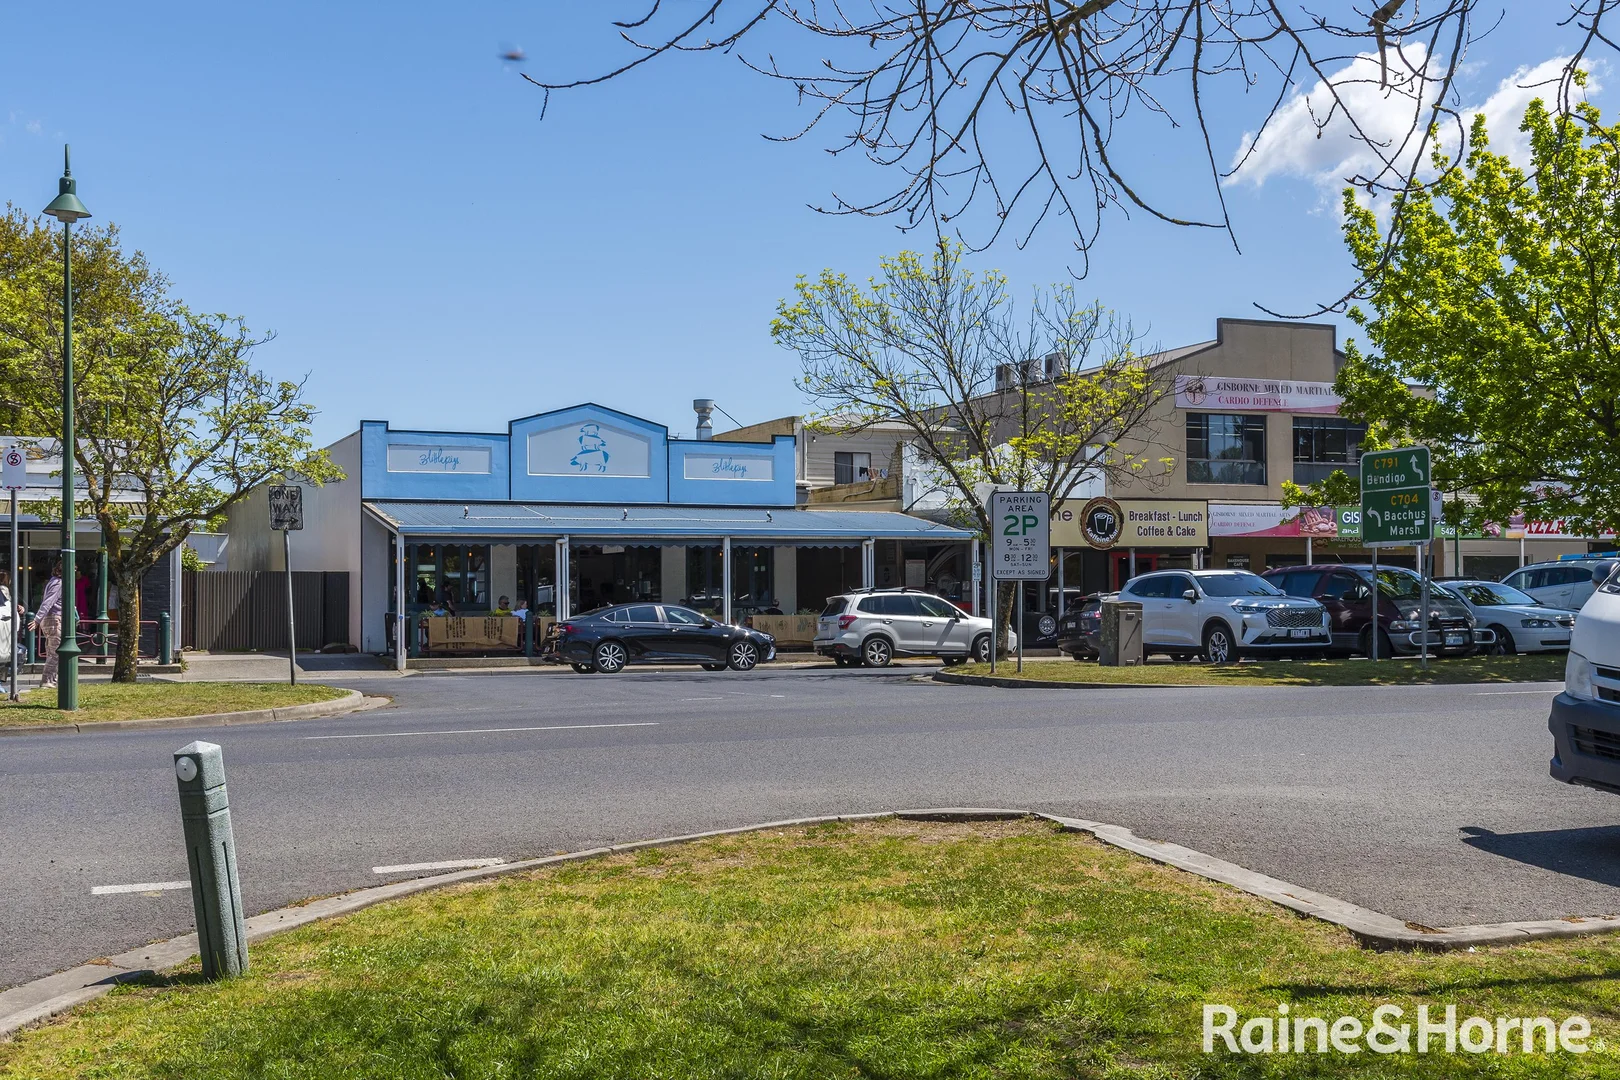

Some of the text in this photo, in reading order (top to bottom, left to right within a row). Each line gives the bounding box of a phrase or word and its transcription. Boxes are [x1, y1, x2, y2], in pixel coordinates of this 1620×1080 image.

[1217, 382, 1260, 393] GISBORNE
[1264, 384, 1292, 394] MIXED
[1218, 396, 1289, 407] CARDIO DEFENCE
[1374, 457, 1398, 470] C791
[1367, 473, 1406, 485] Bendigo
[274, 490, 298, 500] ONE
[999, 496, 1042, 504] PARKING
[1390, 494, 1419, 506] C704
[272, 503, 298, 513] WAY
[1129, 510, 1170, 522] Breakfast
[1178, 510, 1203, 522] Lunch
[1384, 510, 1426, 521] Bacchus
[1003, 514, 1039, 536] 2P
[1137, 525, 1196, 537] Coffee & Cake
[1389, 525, 1420, 536] Marsh
